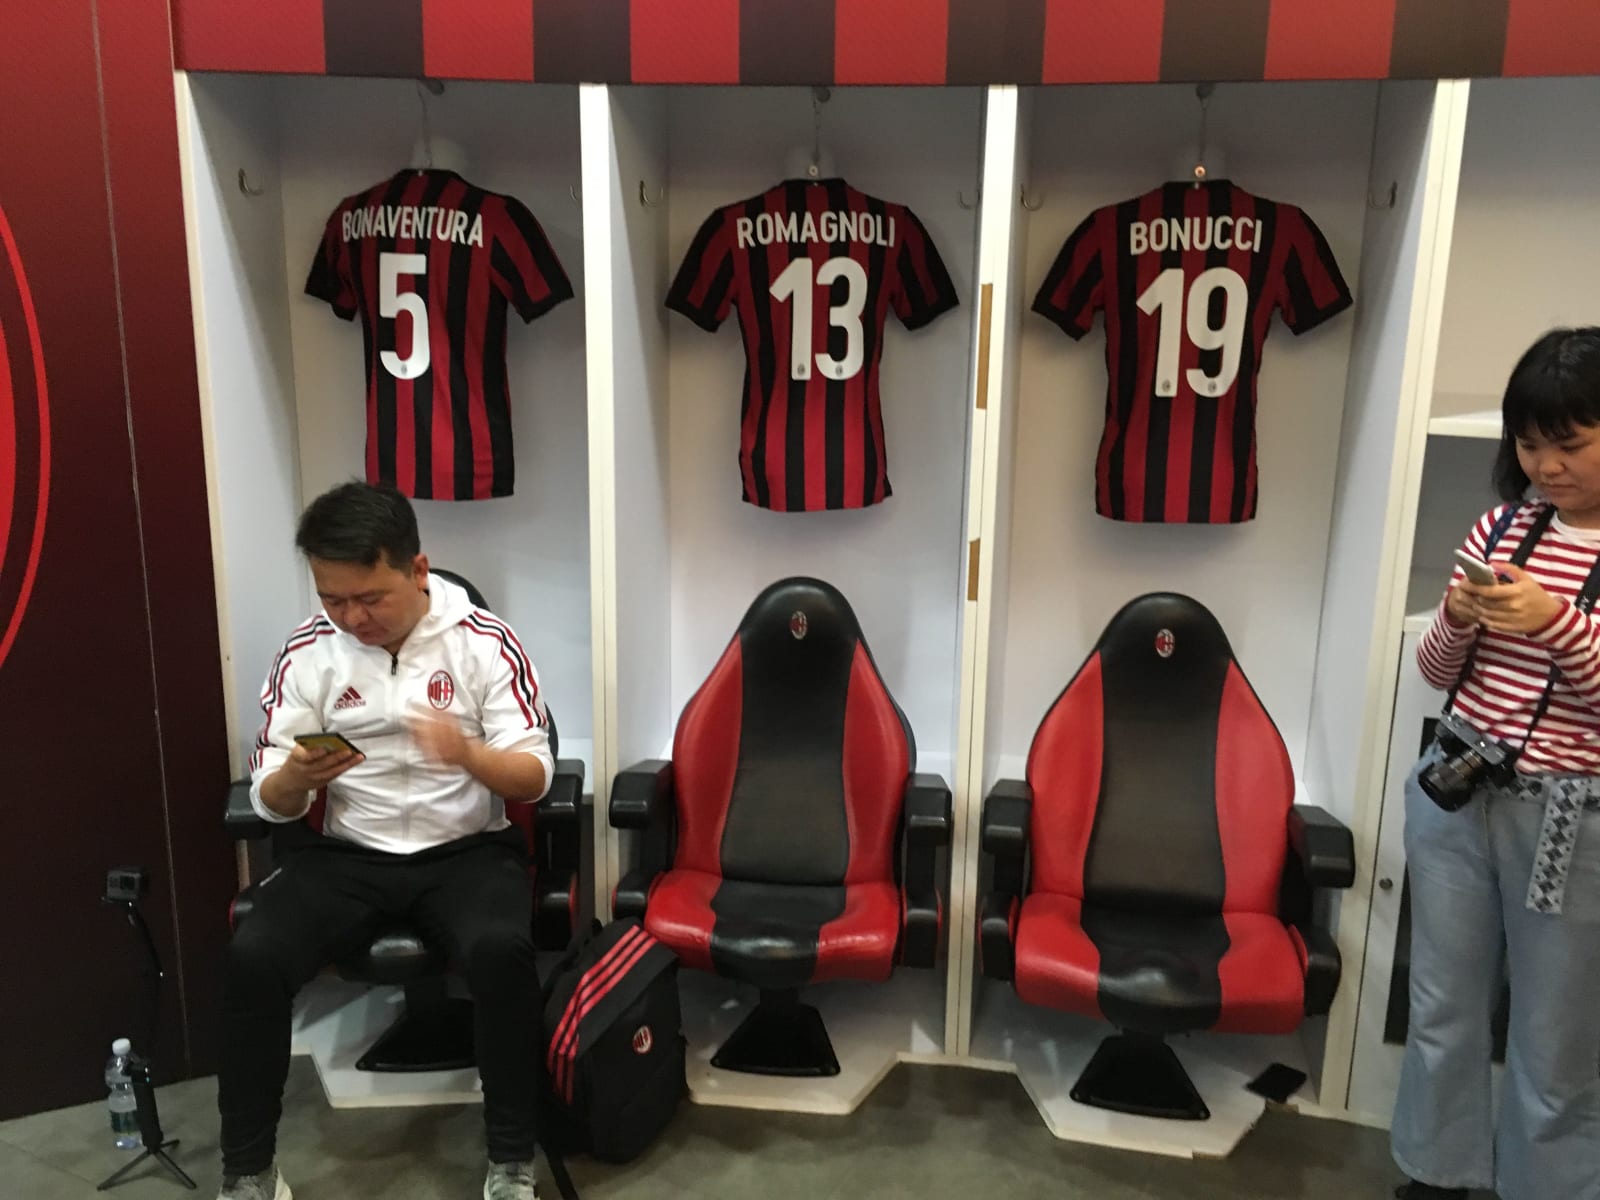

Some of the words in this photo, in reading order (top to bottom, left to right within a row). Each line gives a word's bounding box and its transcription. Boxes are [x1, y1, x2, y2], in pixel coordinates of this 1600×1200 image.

[342, 205, 483, 248] BONAVENTURA
[736, 211, 896, 249] ROMAGNOLI
[1130, 216, 1263, 255] BONUCCI
[379, 252, 431, 380] 5
[769, 257, 868, 381] 13
[1136, 267, 1249, 398] 19
